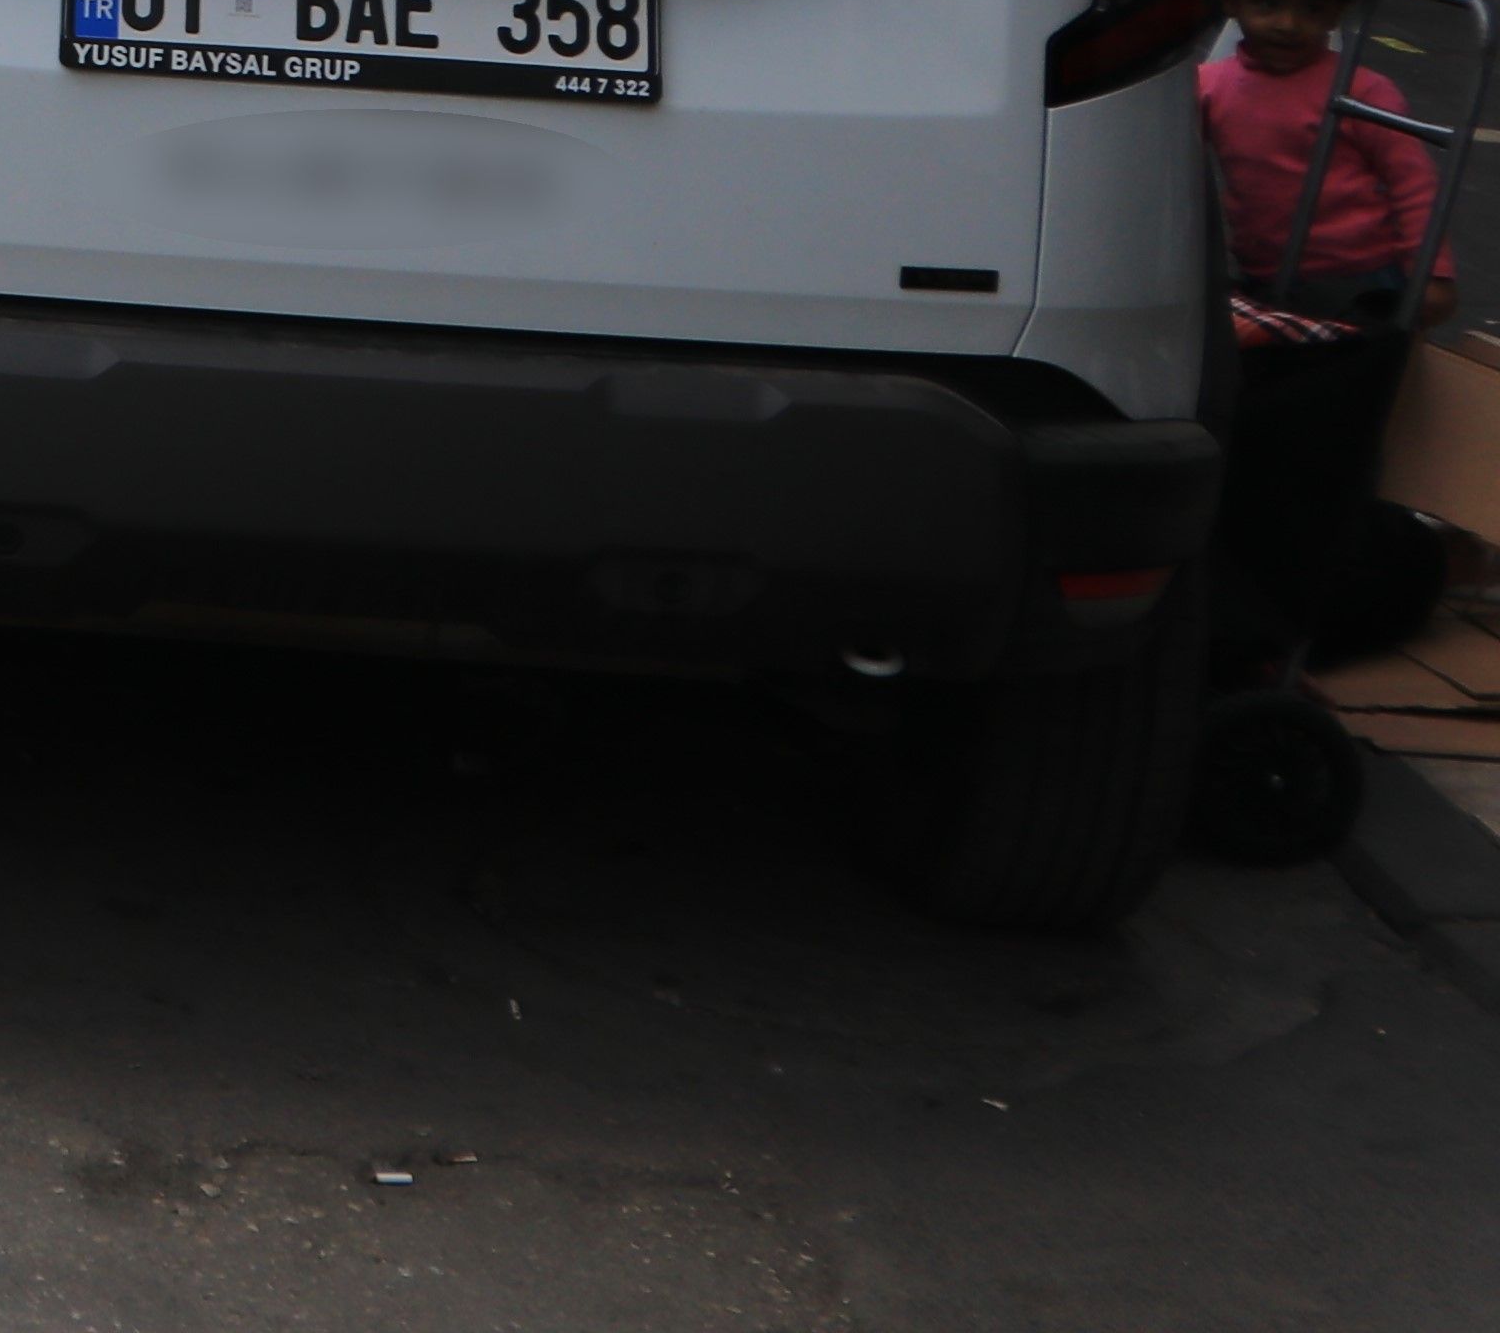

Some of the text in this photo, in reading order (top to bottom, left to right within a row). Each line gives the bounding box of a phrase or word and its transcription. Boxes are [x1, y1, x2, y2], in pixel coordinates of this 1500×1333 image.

[72, 42, 651, 98] YUSUF BAYSAL GRUP 444 7 322
